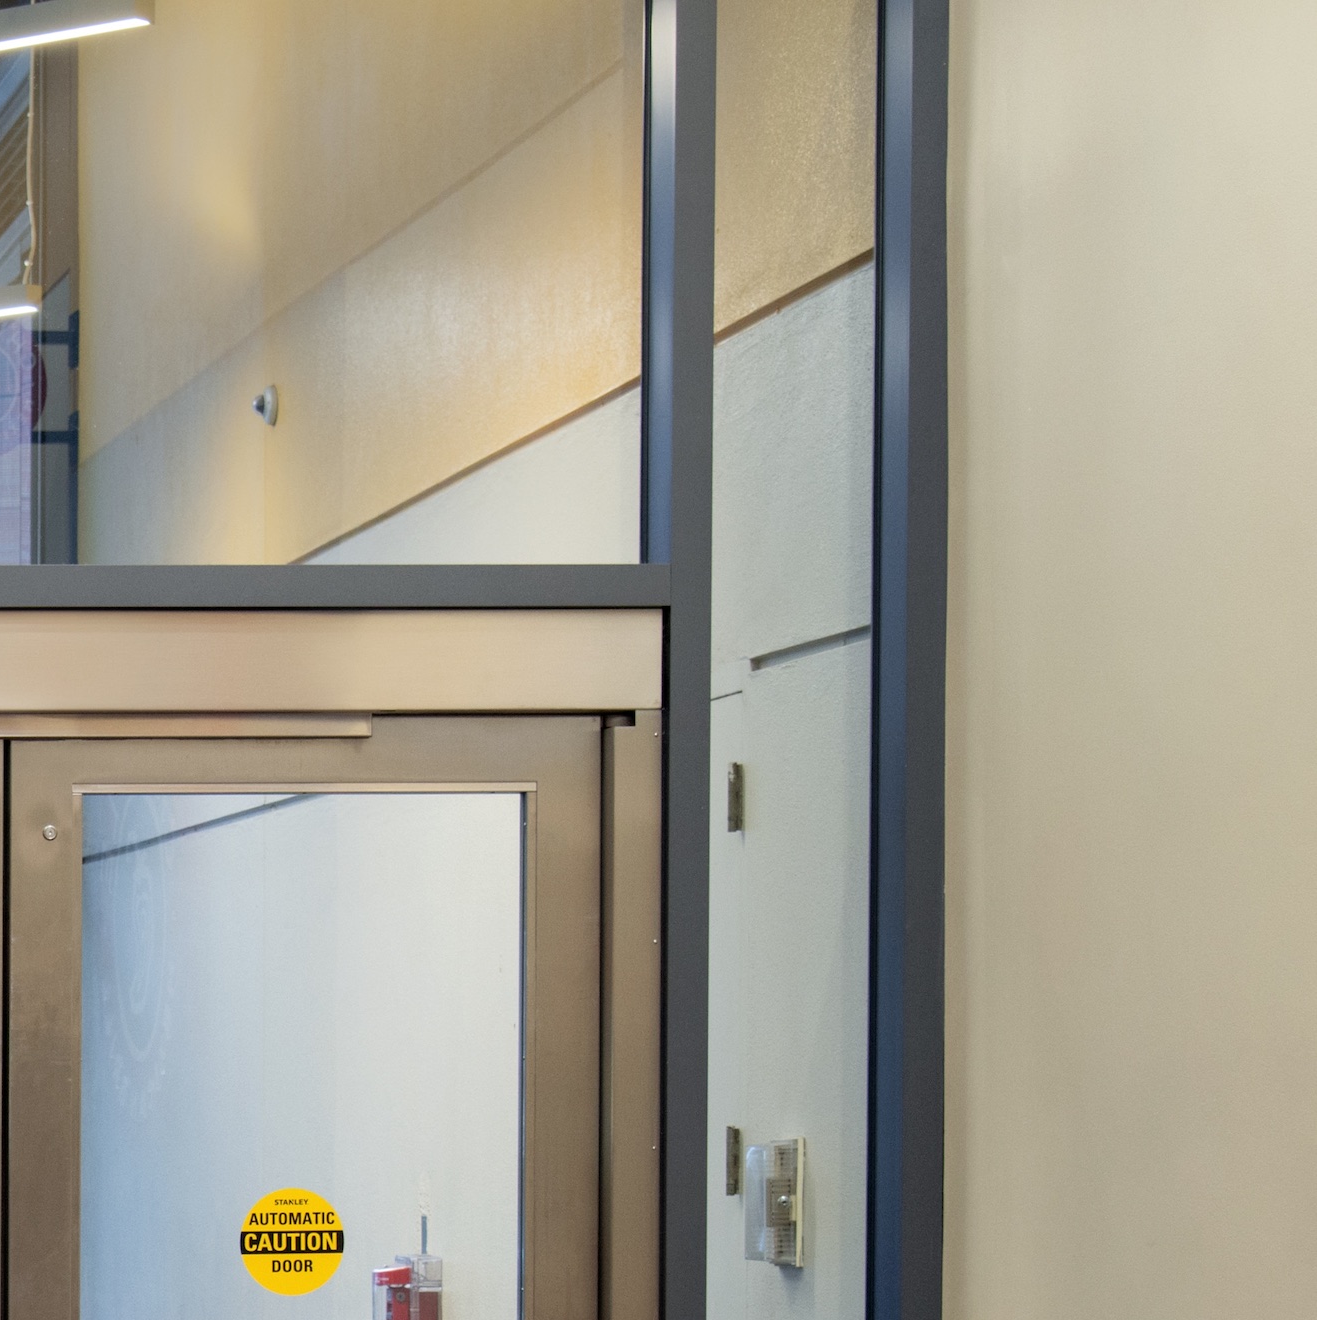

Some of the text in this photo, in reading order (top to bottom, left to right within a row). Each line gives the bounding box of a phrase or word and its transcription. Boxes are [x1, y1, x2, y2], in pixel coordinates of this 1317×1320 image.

[274, 1198, 309, 1206] STANLEY
[248, 1211, 335, 1226] AUTOMATIC
[243, 1232, 338, 1252] CAUTION
[271, 1259, 314, 1273] DOOR
